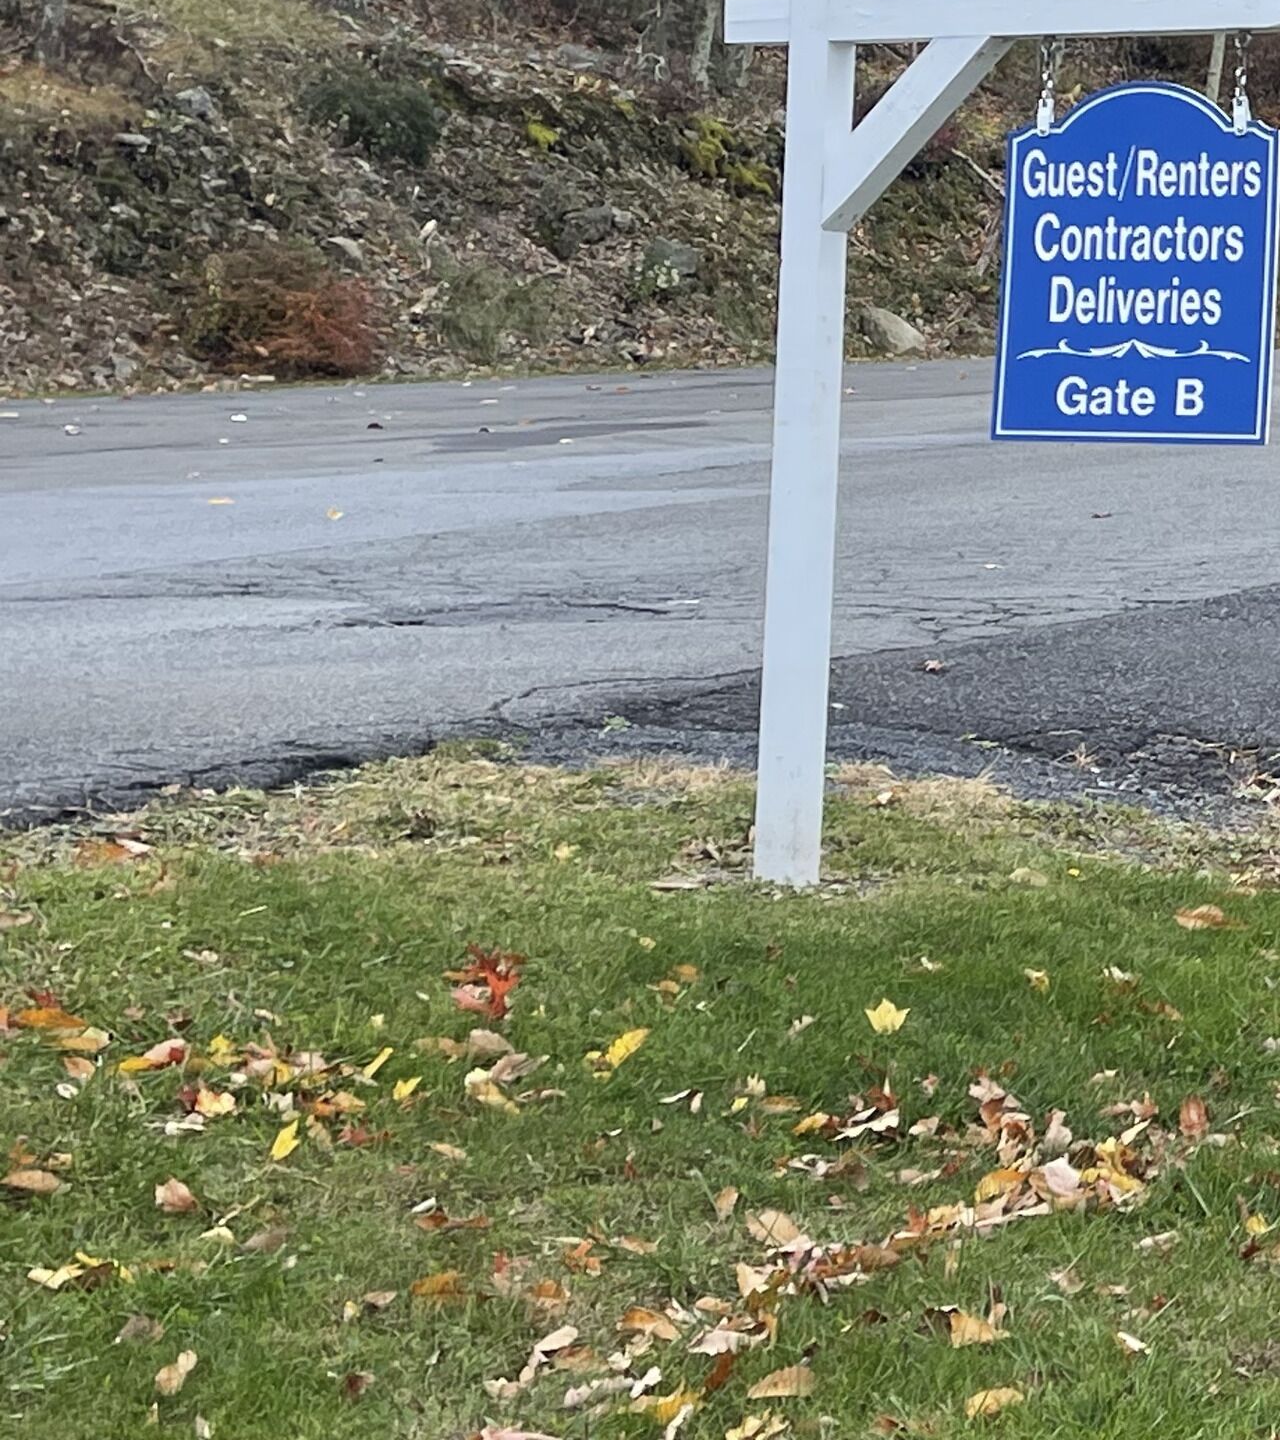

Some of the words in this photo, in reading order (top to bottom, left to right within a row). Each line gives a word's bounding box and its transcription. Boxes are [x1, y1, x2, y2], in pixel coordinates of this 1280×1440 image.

[1034, 212, 1244, 261] Contractors
[1049, 276, 1222, 324] Deliveries
[1056, 375, 1156, 416] Gate
[1174, 378, 1205, 416] B
